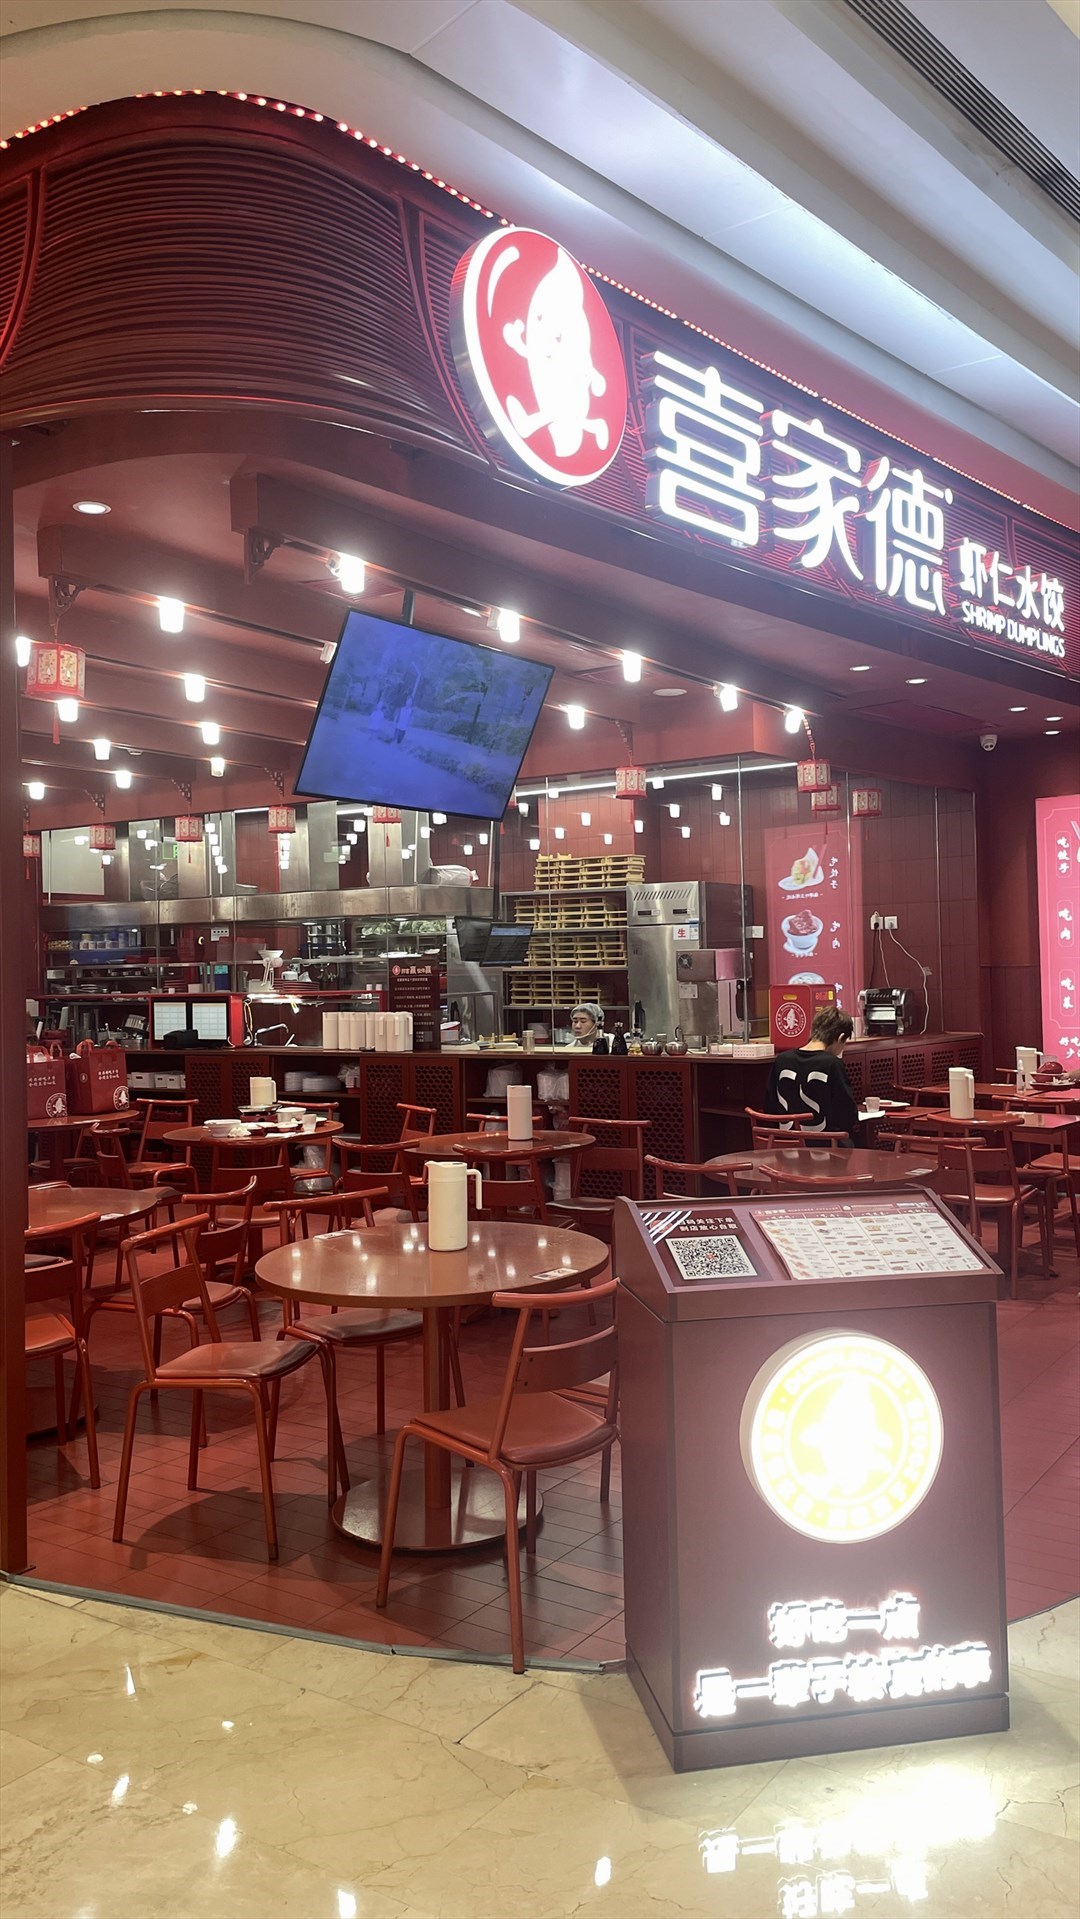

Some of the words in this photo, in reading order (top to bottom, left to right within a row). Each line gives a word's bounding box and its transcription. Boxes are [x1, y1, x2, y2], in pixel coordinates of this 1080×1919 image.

[654, 350, 953, 615] 喜家德
[959, 537, 1065, 632] 虾仁水饺
[961, 600, 1006, 635] SHRIMP
[1007, 619, 1066, 658] DUMPLINGS
[1056, 836, 1070, 874] 吃饺子
[677, 927, 687, 938] 生
[1058, 907, 1073, 940] 吃肉
[1060, 977, 1075, 1009] 吃菜
